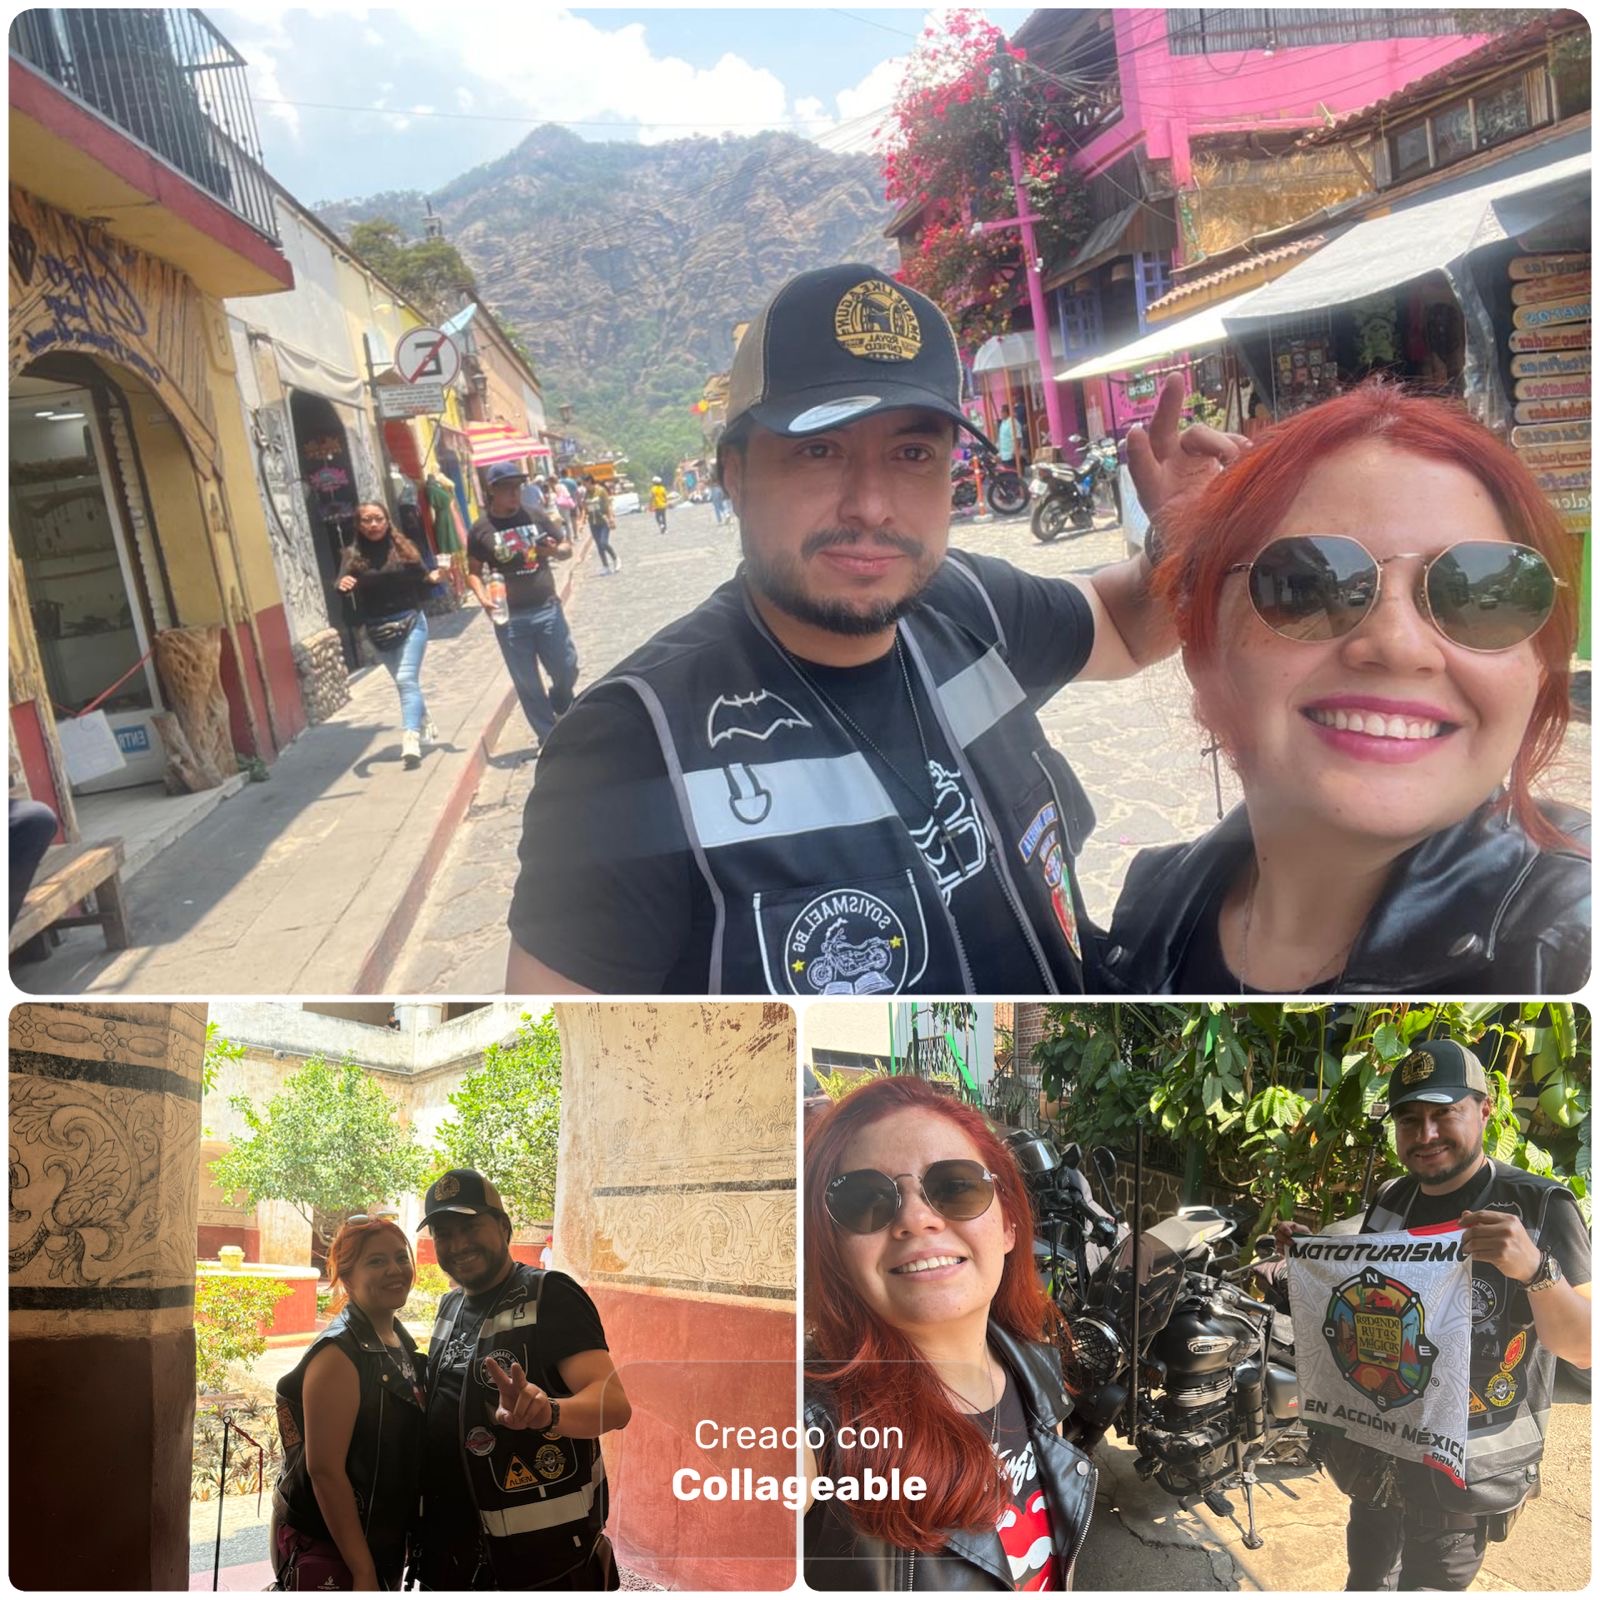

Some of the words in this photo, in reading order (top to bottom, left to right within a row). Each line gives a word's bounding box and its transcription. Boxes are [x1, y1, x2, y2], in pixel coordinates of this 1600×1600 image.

[1365, 1273, 1379, 1284] N
[1418, 1345, 1432, 1357] E
[1377, 1395, 1386, 1406] S
[1304, 1399, 1328, 1414] EN
[1332, 1404, 1397, 1435] ACCIÓN
[1401, 1424, 1465, 1465] MÉXICO
[509, 1475, 534, 1487] ALIEN
